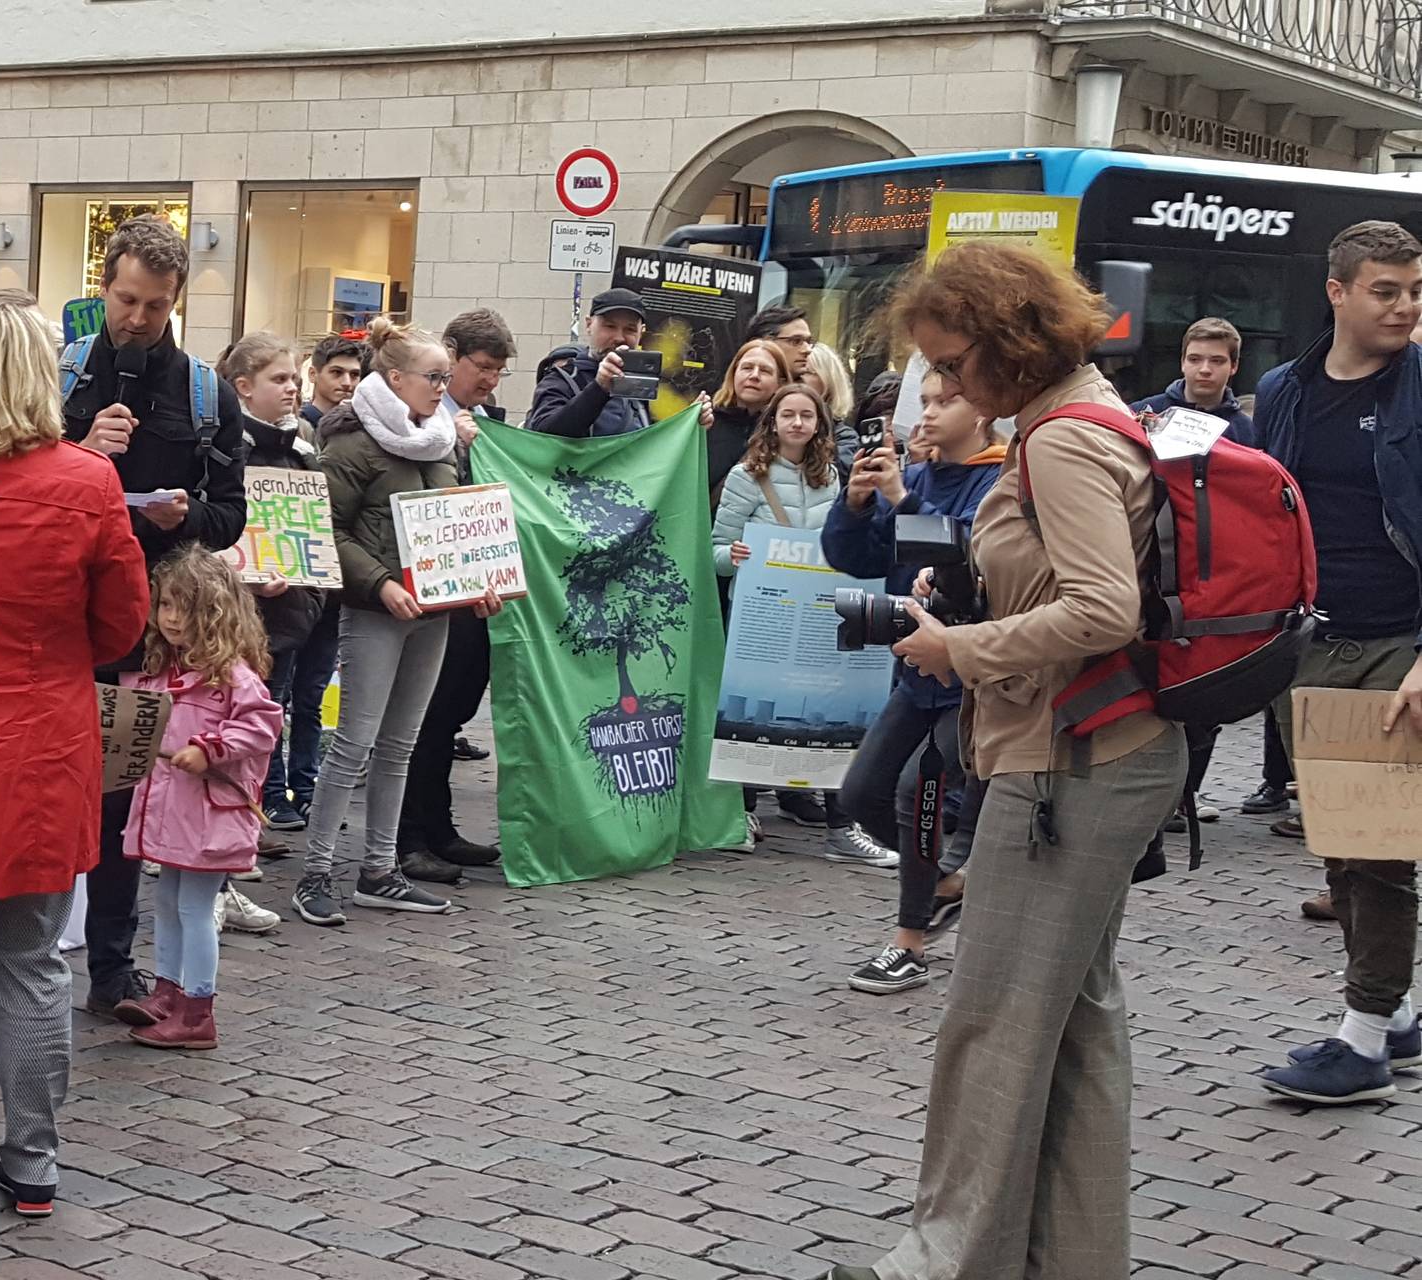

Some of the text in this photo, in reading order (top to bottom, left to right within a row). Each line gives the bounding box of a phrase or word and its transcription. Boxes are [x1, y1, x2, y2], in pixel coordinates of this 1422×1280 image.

[1143, 104, 1310, 167] TOMMY HILFIGER
[556, 225, 582, 235] Linien-
[946, 210, 1058, 231] AKTIV WERDEN
[1132, 192, 1294, 242] schäpers
[562, 243, 576, 252] und
[572, 258, 590, 268] frei
[625, 257, 660, 280] WAS
[665, 261, 712, 287] WÄRE
[714, 269, 755, 294] WENN
[405, 499, 502, 521] TIERE verlieren
[436, 517, 509, 545] LEBENSRAUM
[767, 537, 815, 564] FAST
[485, 566, 519, 590] KAUM
[590, 720, 649, 748] HAMBACHER
[613, 747, 675, 792] BLEIBT!
[923, 780, 936, 811] EOS
[920, 814, 934, 830] 5D
